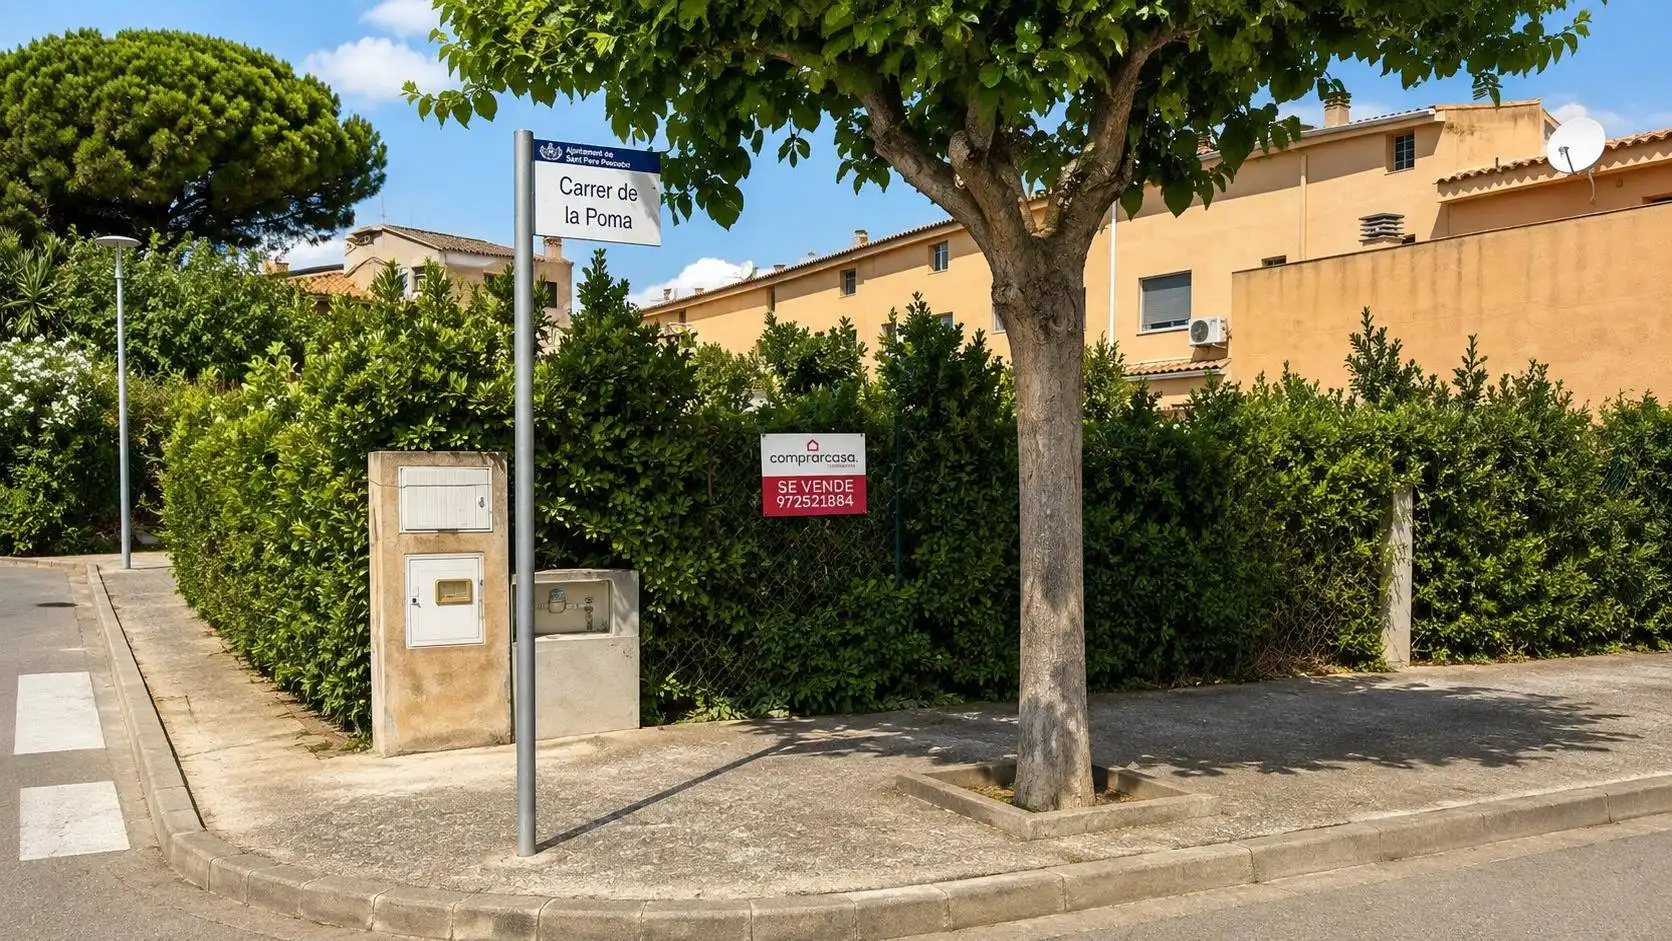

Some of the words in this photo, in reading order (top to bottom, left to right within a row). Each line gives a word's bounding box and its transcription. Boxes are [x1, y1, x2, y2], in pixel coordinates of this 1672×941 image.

[560, 176, 612, 199] Carrer
[618, 183, 638, 202] de
[565, 206, 580, 225] la
[586, 207, 632, 229] Poma
[778, 480, 797, 493] SE
[801, 479, 854, 493] VENDE
[776, 494, 854, 508] 972521884
